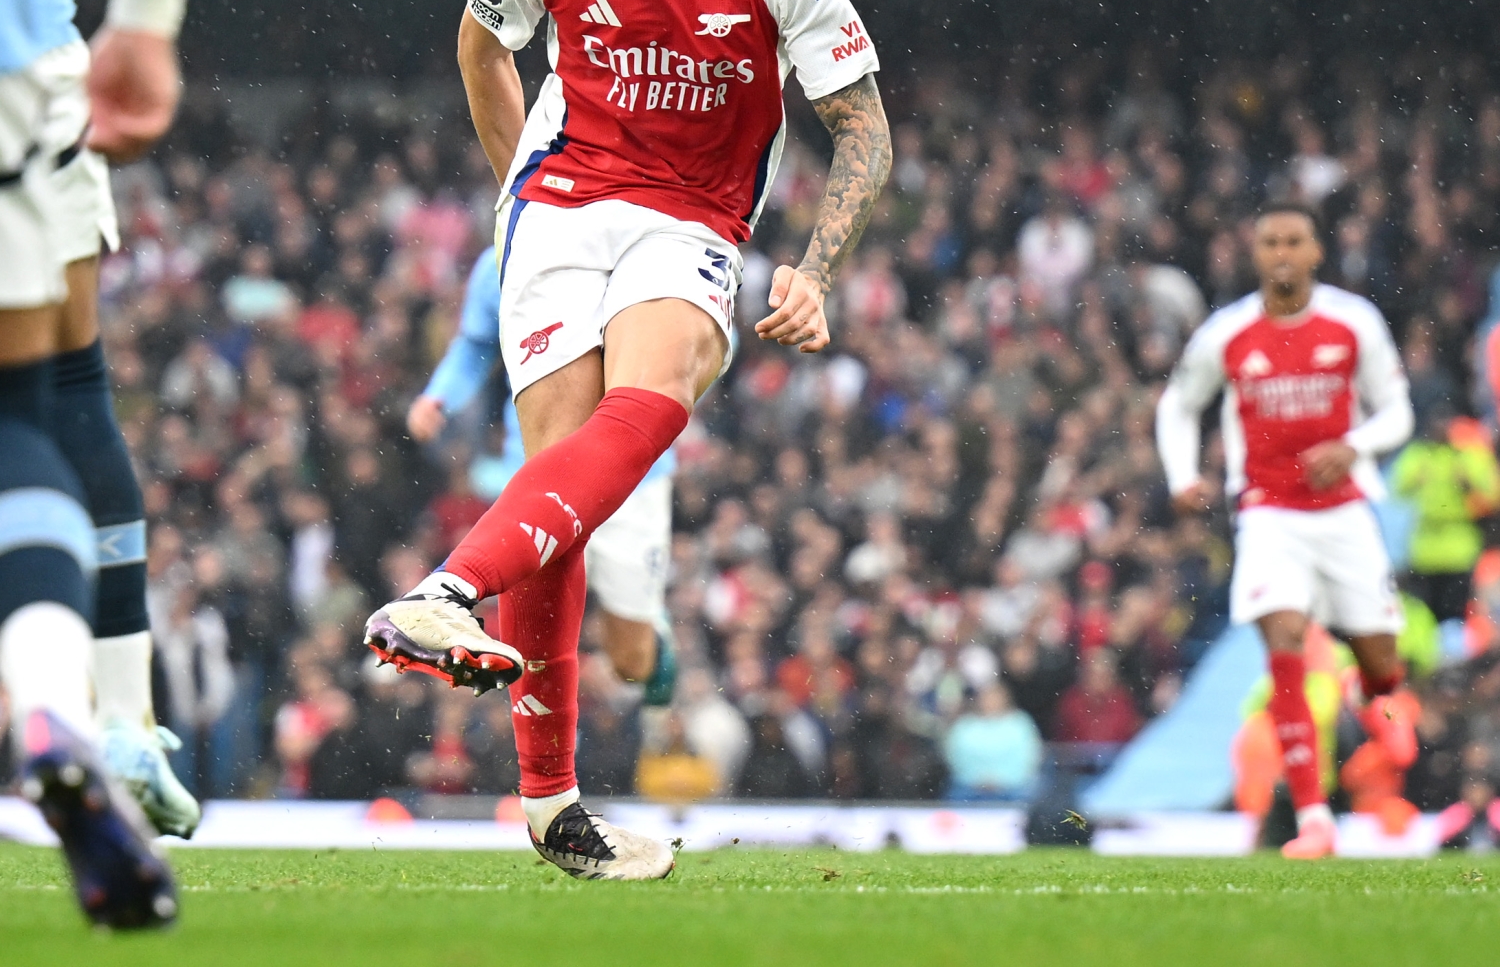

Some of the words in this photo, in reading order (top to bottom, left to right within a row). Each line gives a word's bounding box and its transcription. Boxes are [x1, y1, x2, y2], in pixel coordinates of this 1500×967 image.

[582, 34, 755, 84] Emirates
[606, 75, 640, 112] FLY
[645, 81, 728, 112] BETTER
